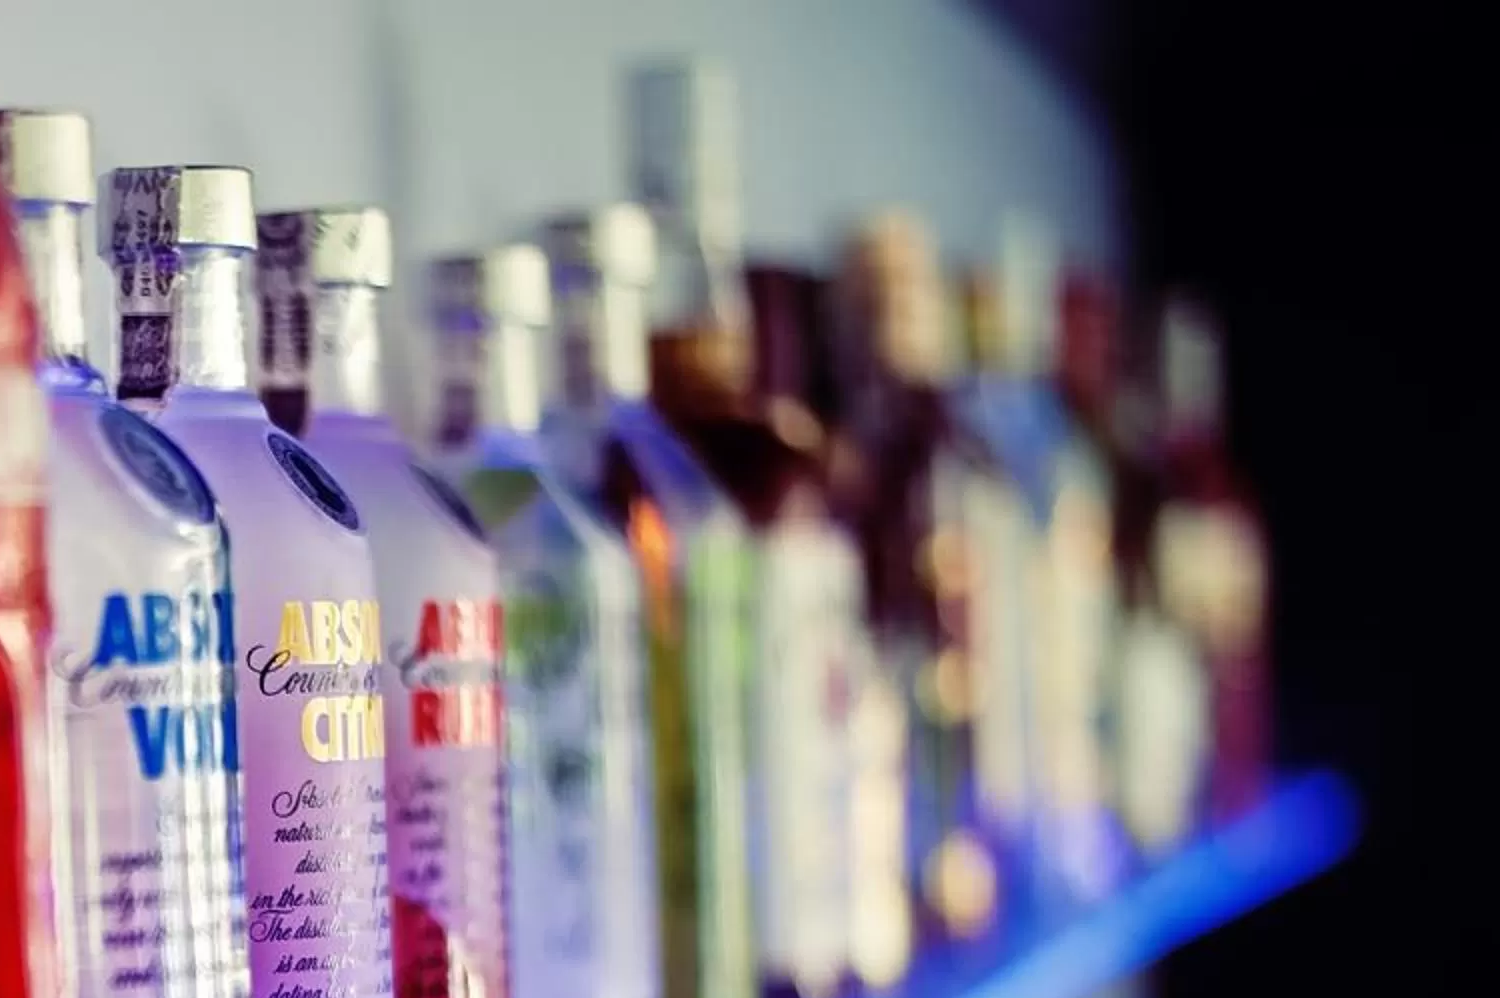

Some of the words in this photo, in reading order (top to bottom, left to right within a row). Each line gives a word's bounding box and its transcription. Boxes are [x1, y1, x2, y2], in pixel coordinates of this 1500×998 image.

[276, 883, 304, 907] the
[250, 908, 293, 943] The
[273, 954, 292, 973] is
[293, 956, 318, 973] an
